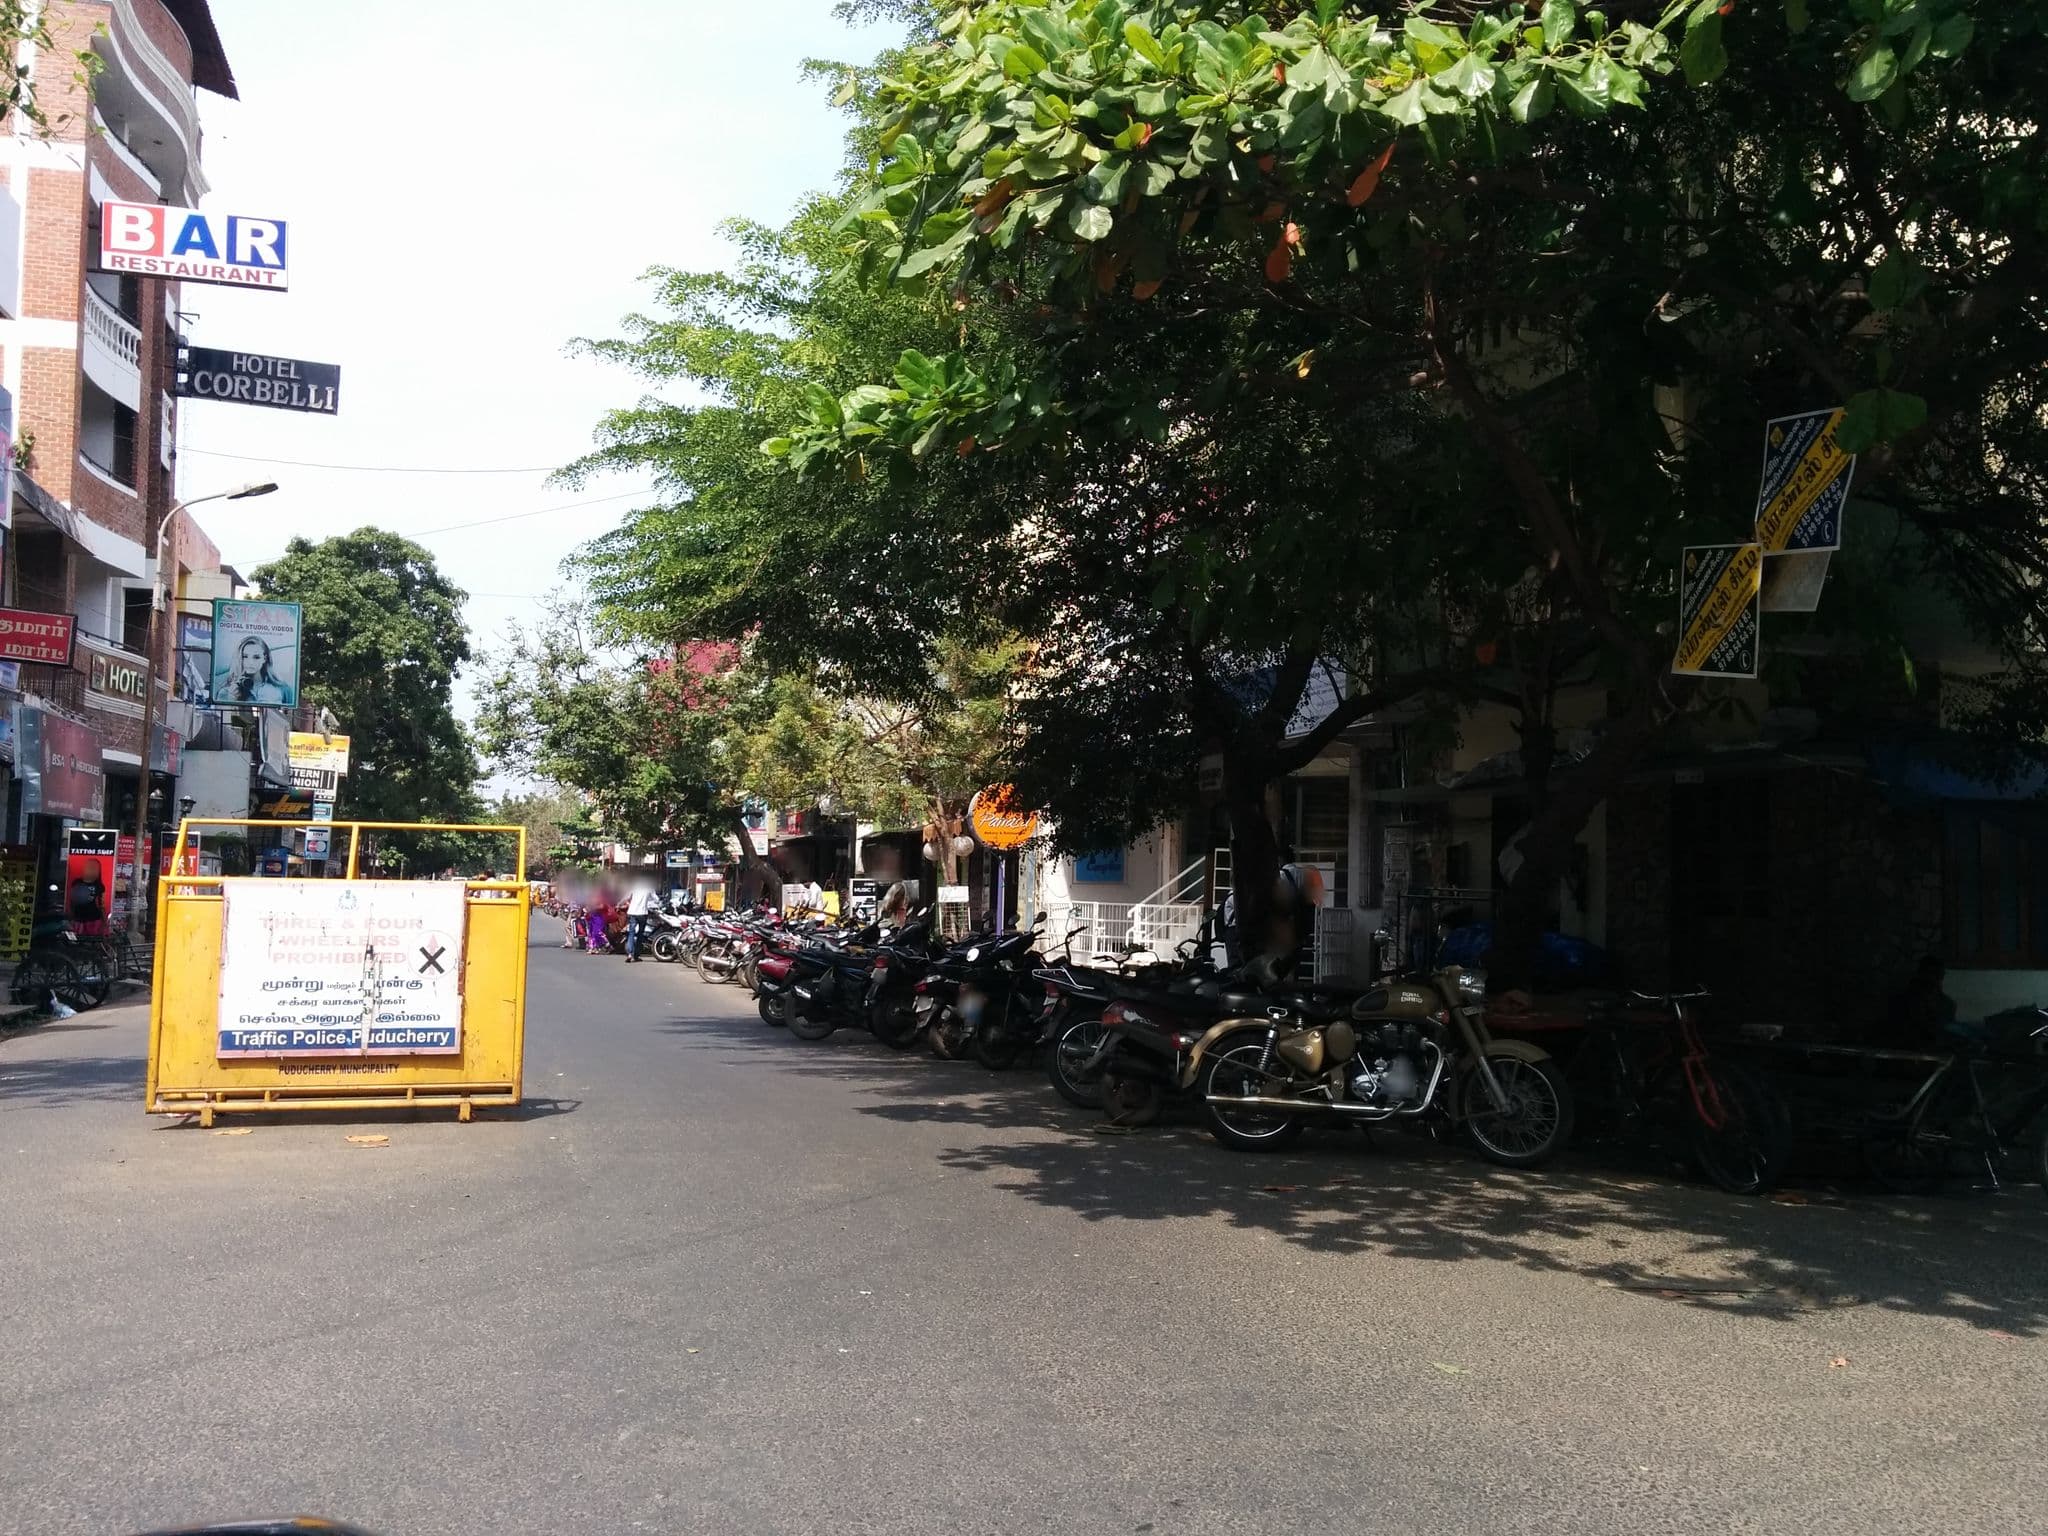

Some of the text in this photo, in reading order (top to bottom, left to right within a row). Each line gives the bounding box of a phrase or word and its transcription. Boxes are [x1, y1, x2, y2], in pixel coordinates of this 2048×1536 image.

[110, 204, 281, 266] BAR
[111, 255, 278, 284] RESTAURANT
[233, 353, 300, 380] HOTEL
[193, 370, 335, 411] CORBELLI
[109, 664, 144, 697] HOTE
[258, 918, 424, 929] THREE & FOUR
[281, 935, 400, 947] WHEELERS
[262, 976, 323, 993] மூன்று
[277, 996, 319, 1007] சக்கர
[375, 1010, 441, 1023] இல்லை
[231, 1030, 288, 1048] Traffic
[293, 1029, 347, 1046] Police
[278, 1063, 400, 1075] PUDUCHERRY MUNICIPALITY
